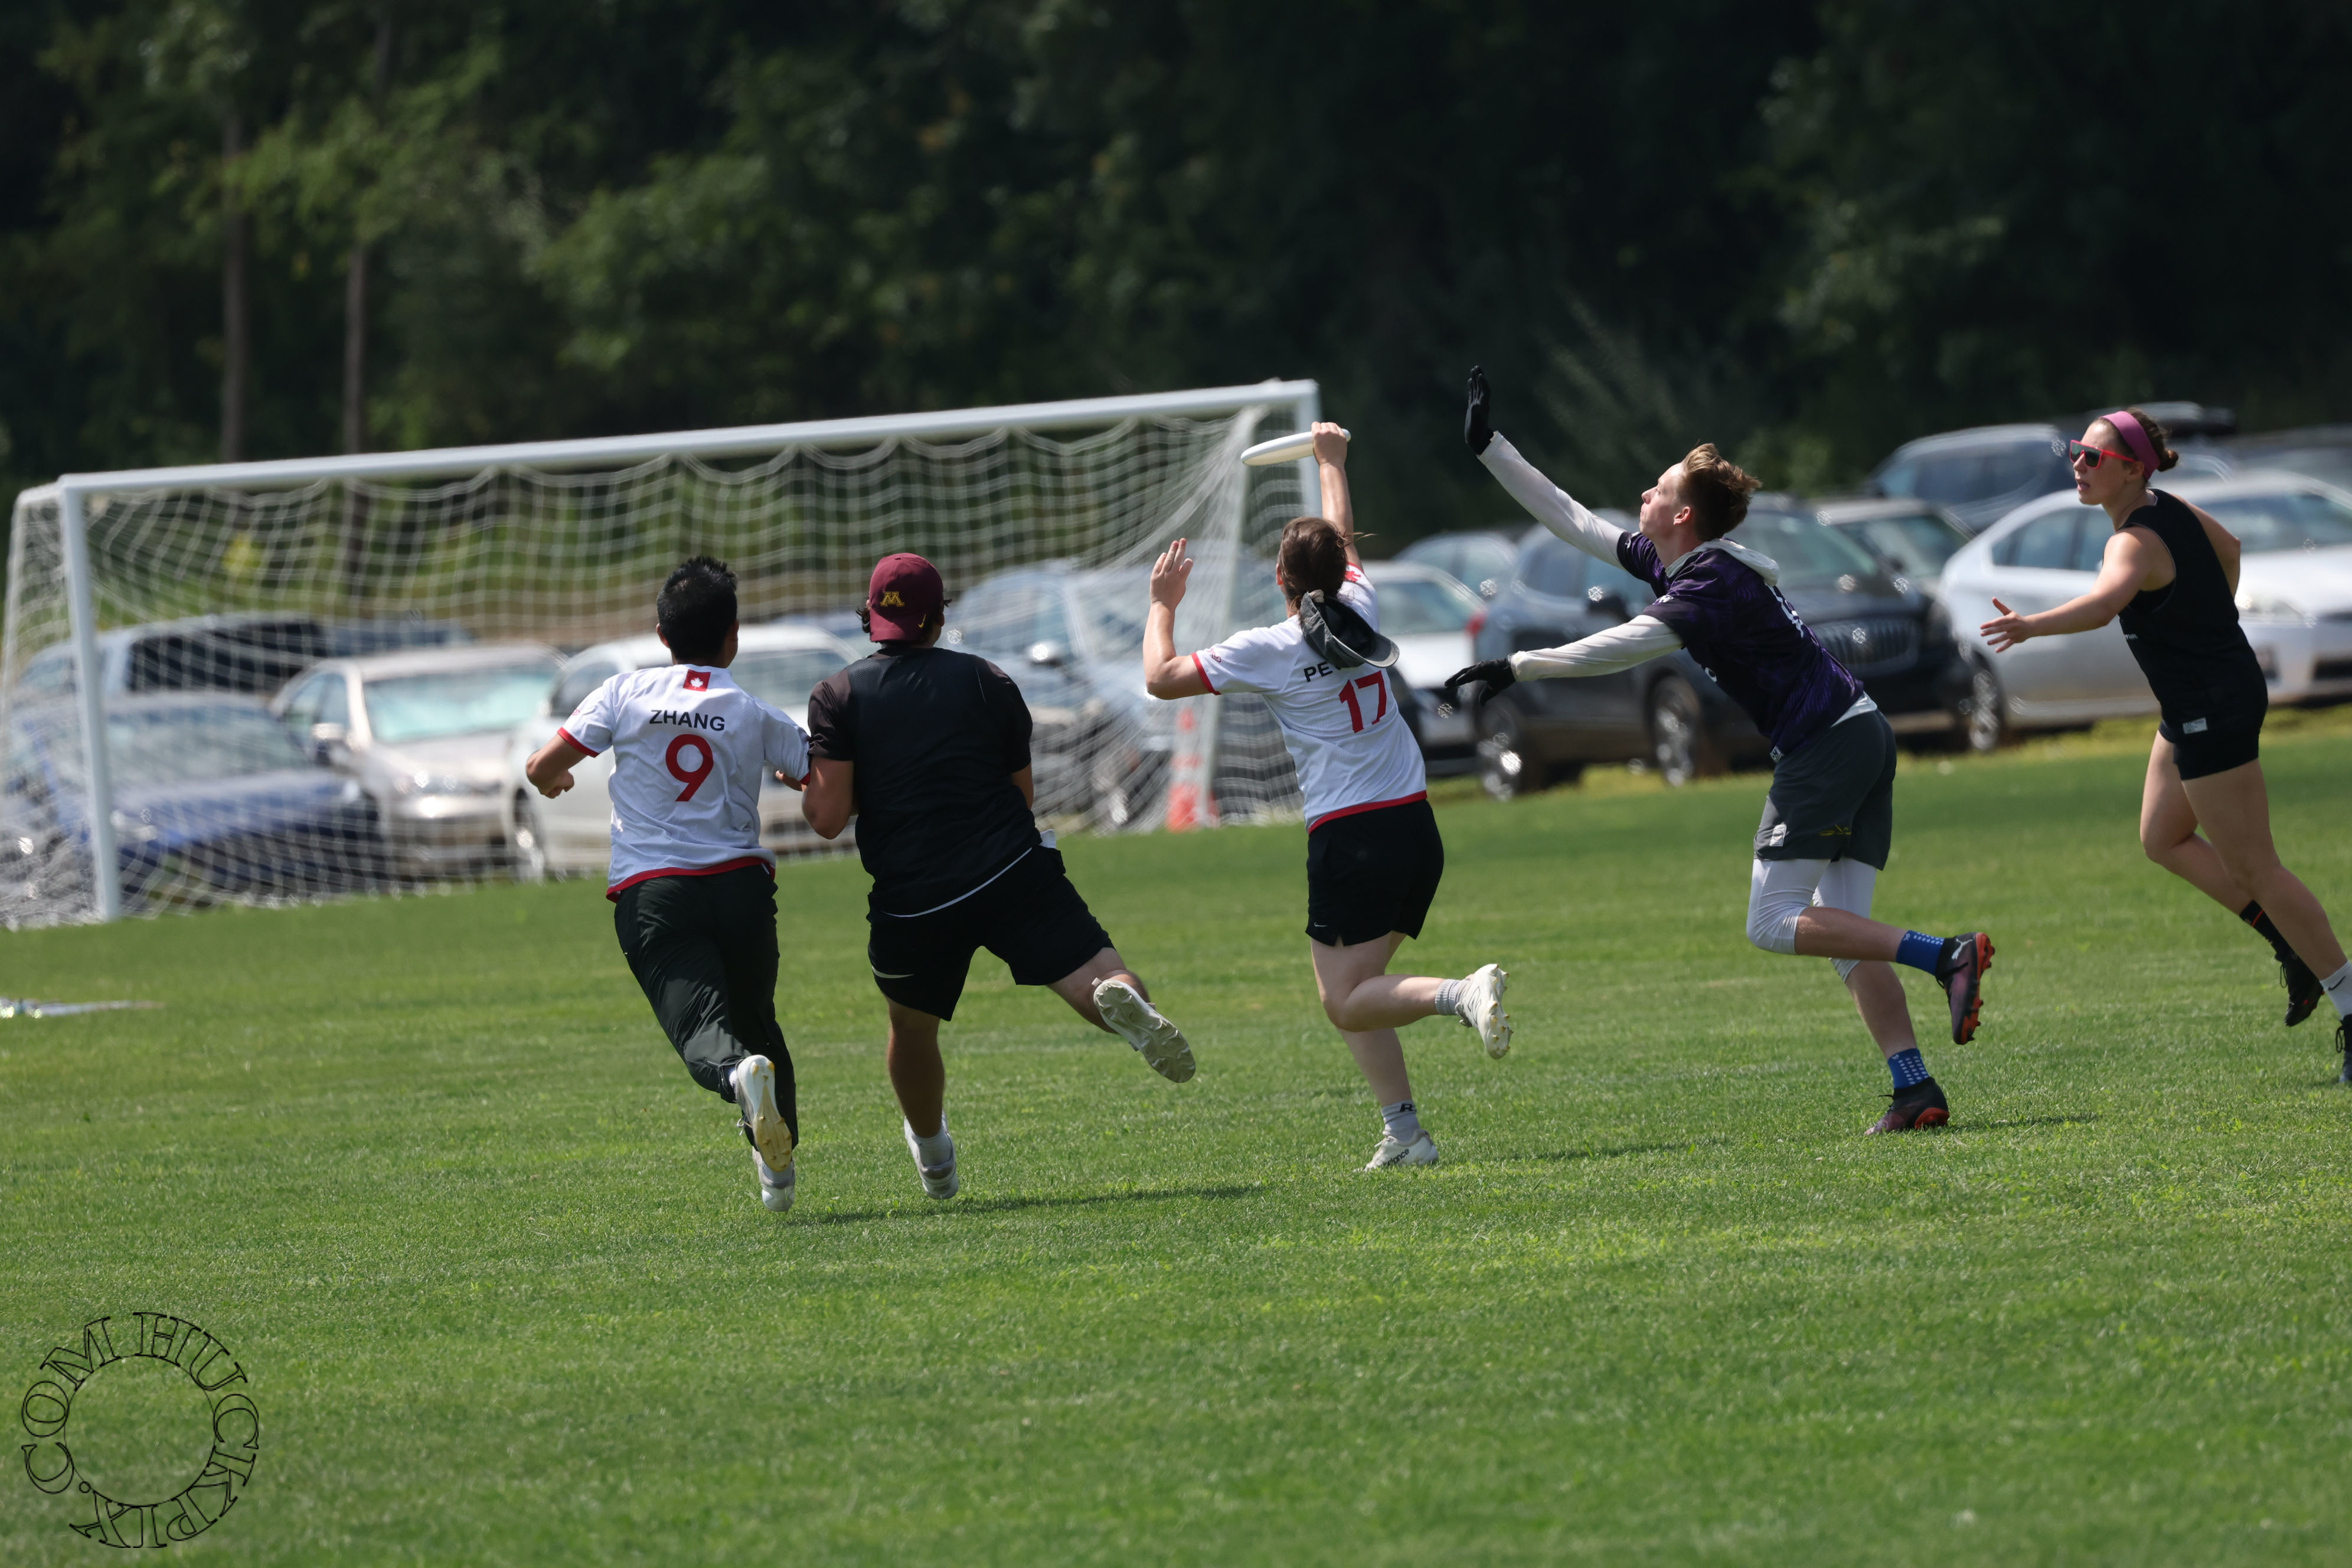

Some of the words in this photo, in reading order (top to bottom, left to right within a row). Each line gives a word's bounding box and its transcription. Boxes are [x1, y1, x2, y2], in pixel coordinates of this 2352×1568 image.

[1304, 661, 1341, 682] PE
[649, 710, 725, 731] ZHANG
[1338, 670, 1387, 733] 17
[665, 734, 714, 802] 9
